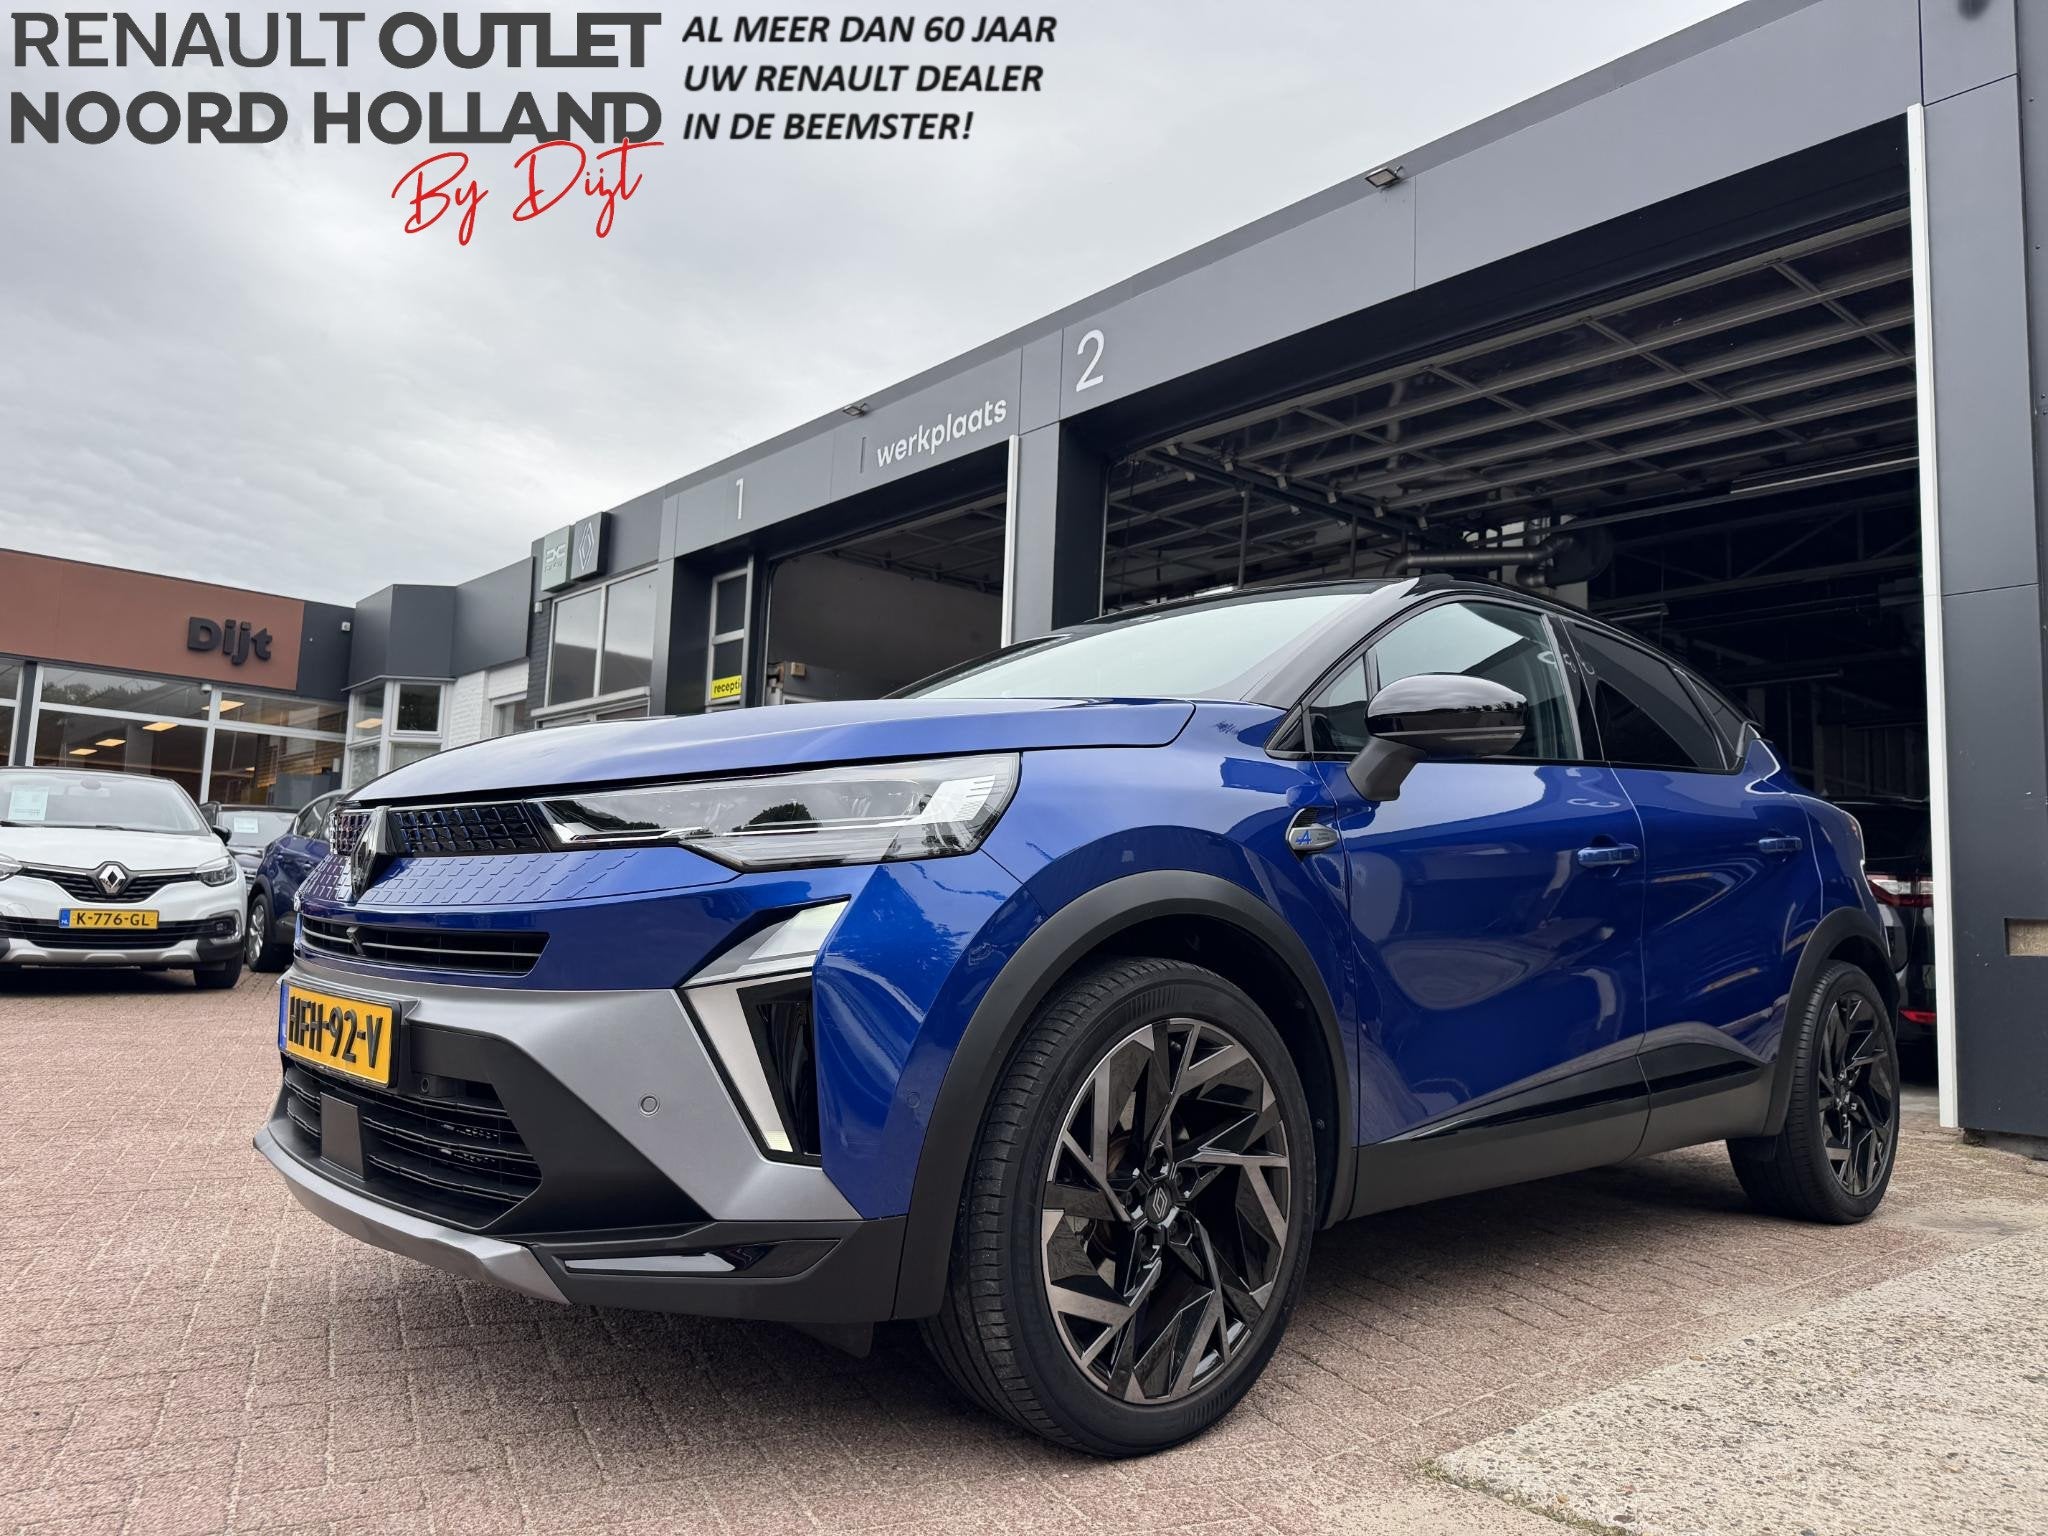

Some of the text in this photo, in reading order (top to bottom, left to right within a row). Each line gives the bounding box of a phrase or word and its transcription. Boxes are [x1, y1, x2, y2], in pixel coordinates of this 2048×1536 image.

[1076, 329, 1105, 392] 2
[876, 399, 1007, 467] werkplaats
[735, 478, 744, 520] 1
[187, 616, 273, 666] Dijt
[76, 912, 150, 926] K-776-GL
